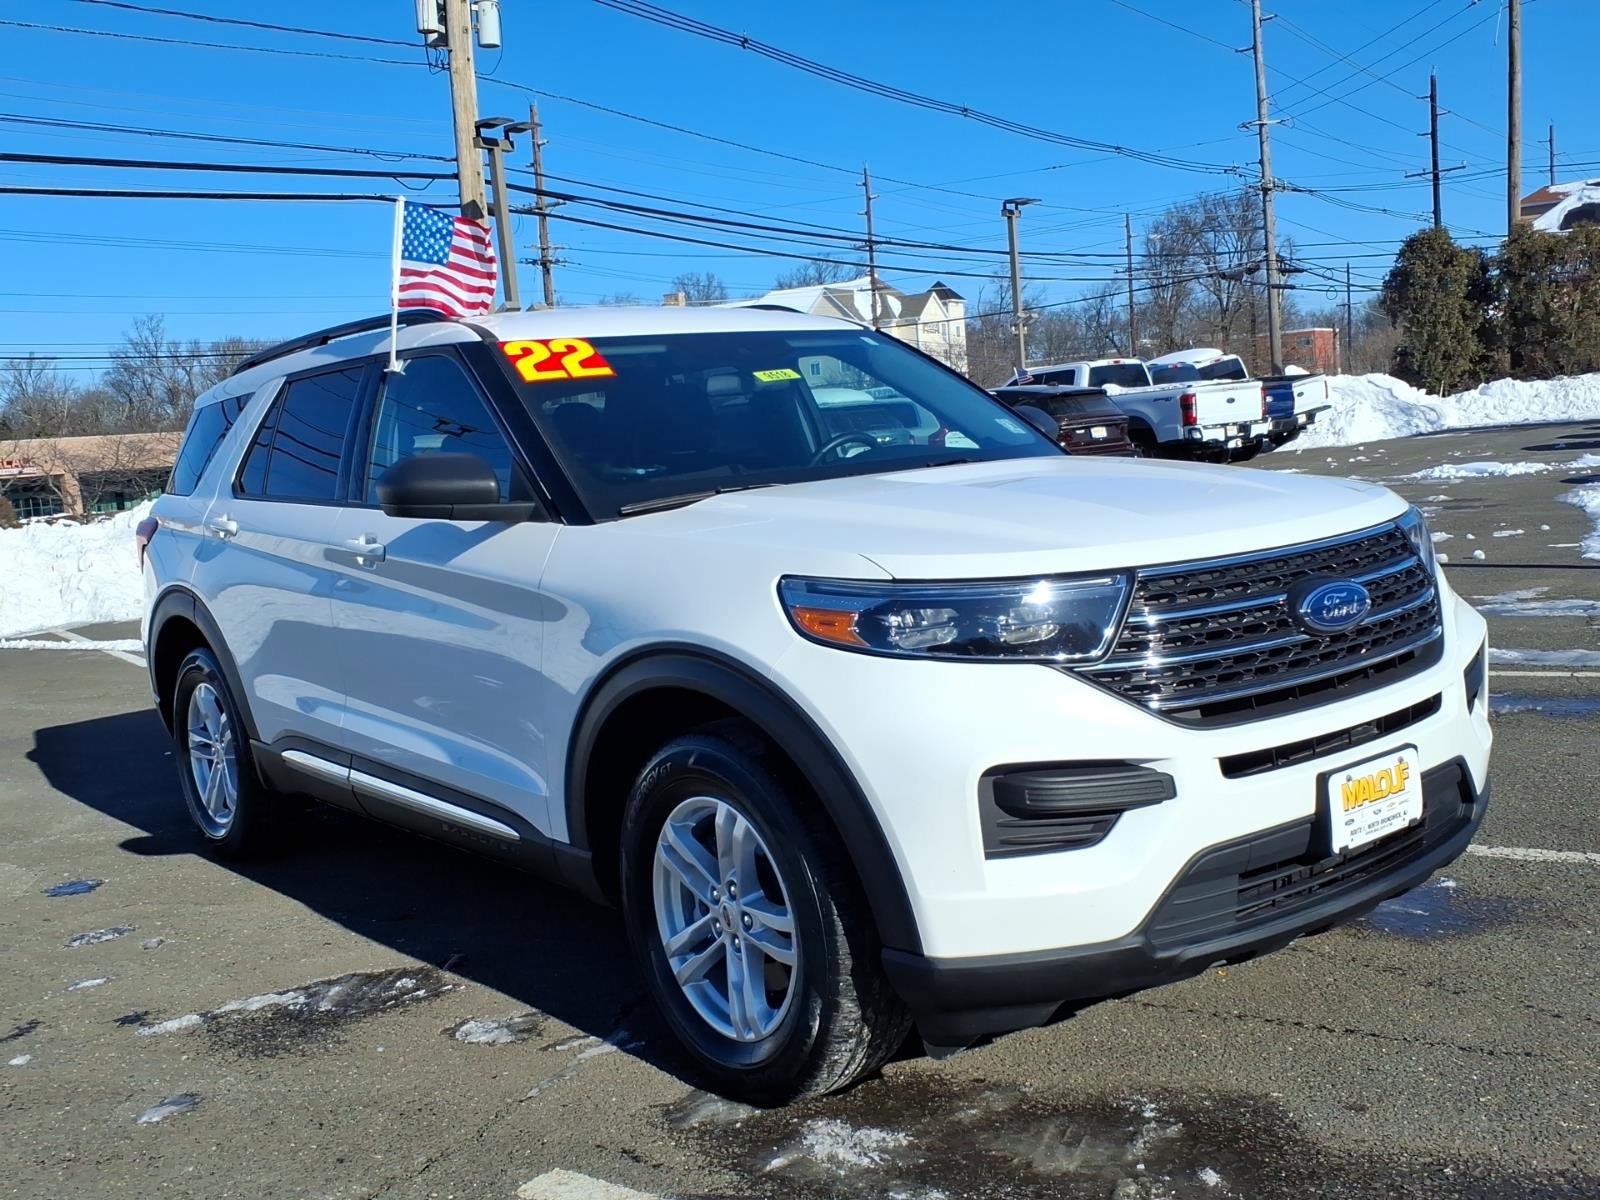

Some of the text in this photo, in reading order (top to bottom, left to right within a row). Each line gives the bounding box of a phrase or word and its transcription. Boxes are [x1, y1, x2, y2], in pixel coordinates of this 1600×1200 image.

[503, 338, 614, 383] 22
[1322, 591, 1360, 620] Ford
[1341, 762, 1409, 812] MALOUF
